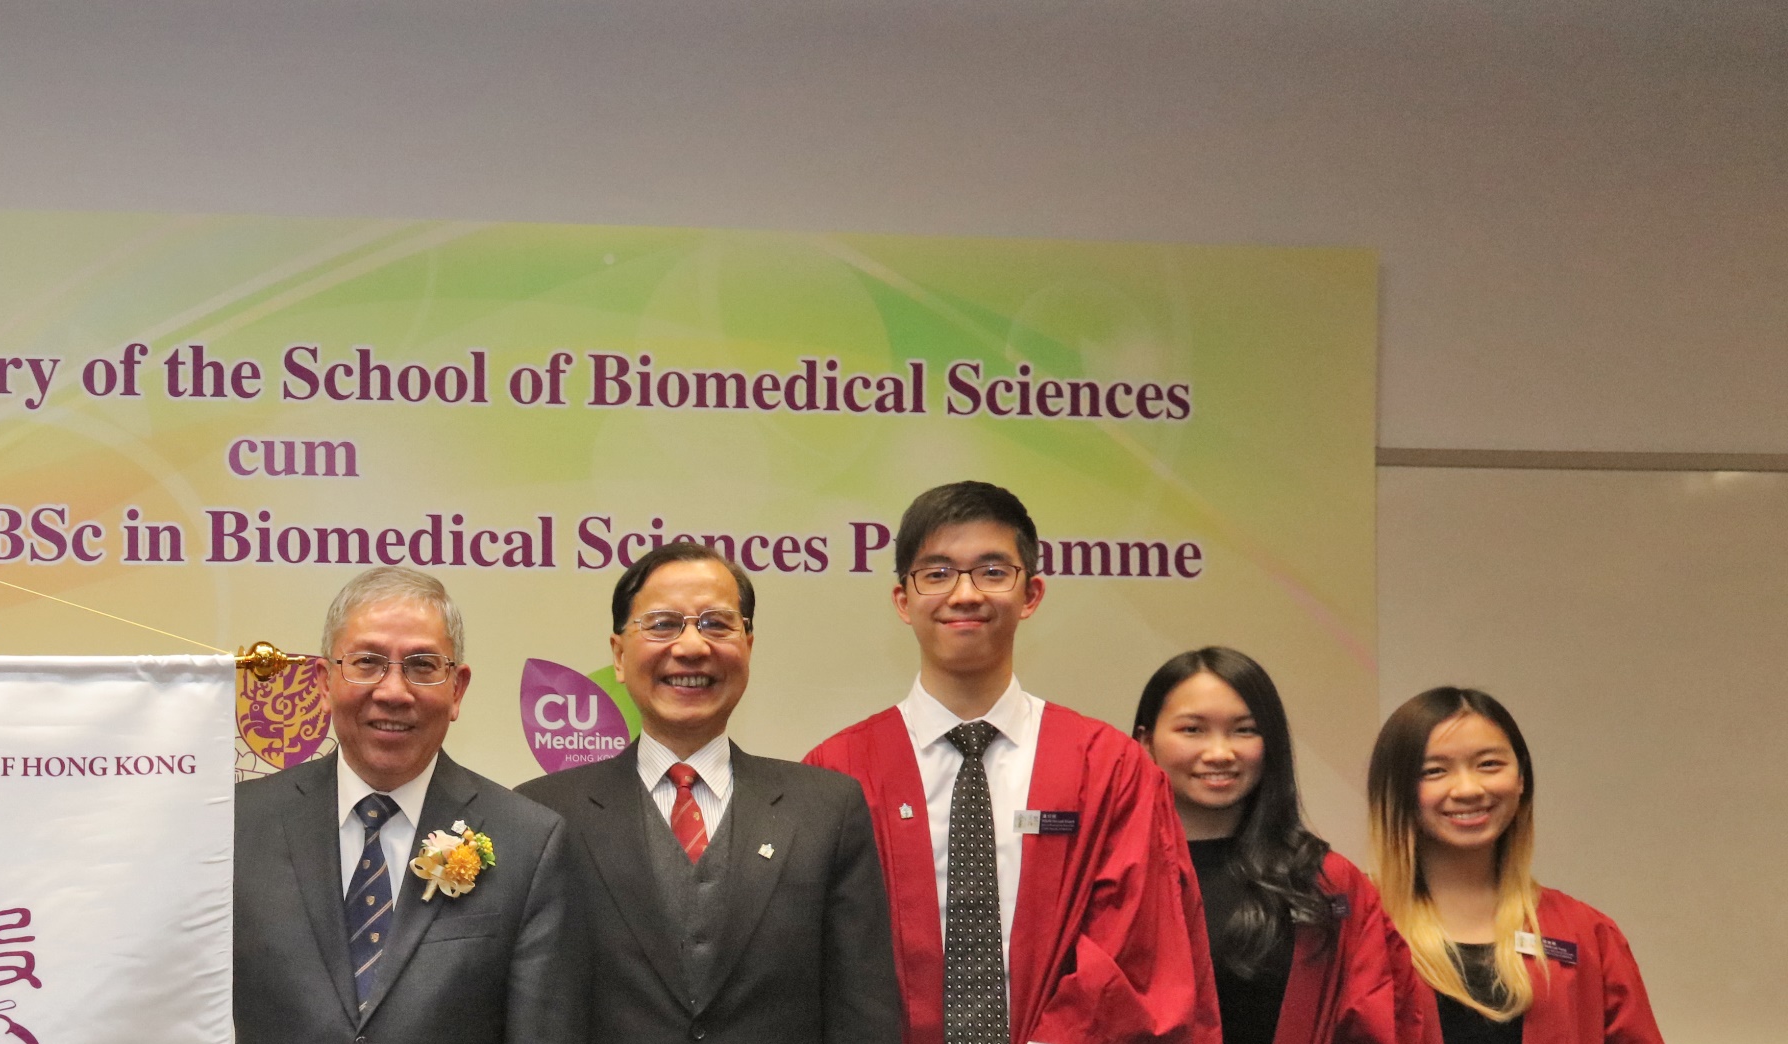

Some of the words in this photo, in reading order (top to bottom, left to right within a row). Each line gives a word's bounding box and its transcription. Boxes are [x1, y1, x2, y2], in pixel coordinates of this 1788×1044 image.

[82, 343, 148, 397] of
[164, 345, 262, 399] the
[282, 346, 488, 404] School
[509, 353, 573, 406] of
[588, 354, 925, 415] Biomedical
[946, 362, 1191, 420] Sciences
[228, 438, 359, 477] cum
[124, 508, 183, 562] in
[207, 509, 557, 569] Biomedical
[849, 521, 1203, 578] Pamme
[534, 693, 599, 731] CU
[534, 731, 626, 750] Medicine
[565, 754, 594, 763] HONG
[21, 756, 109, 778] HONG
[114, 754, 197, 776] KONG
